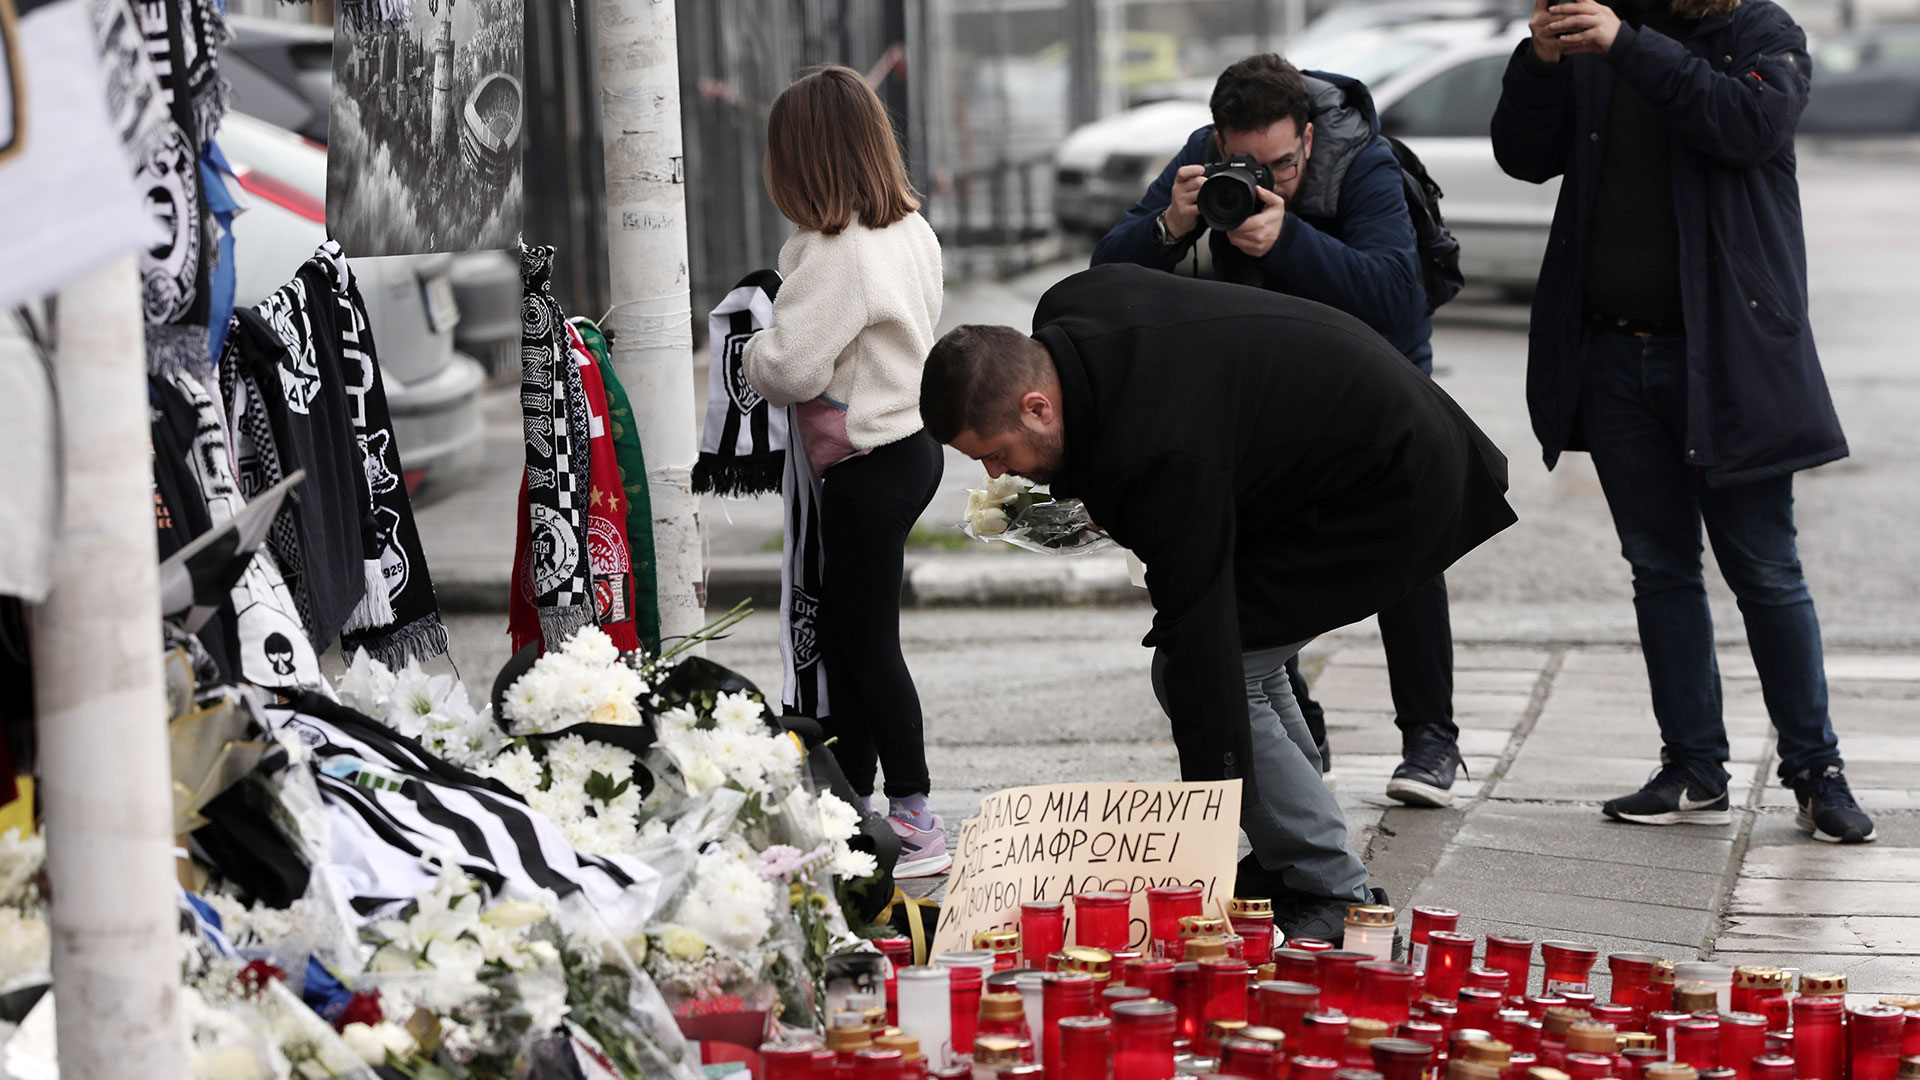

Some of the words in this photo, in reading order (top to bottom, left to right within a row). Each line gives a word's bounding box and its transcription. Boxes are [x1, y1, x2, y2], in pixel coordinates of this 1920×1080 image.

[382, 562, 403, 579] 925
[1039, 790, 1089, 824] ΜΙΑ
[1102, 788, 1224, 826] ΚΡΑΥΓΗ
[991, 827, 1181, 869] ΞΑΛΑΦΡΩΝΕΙ
